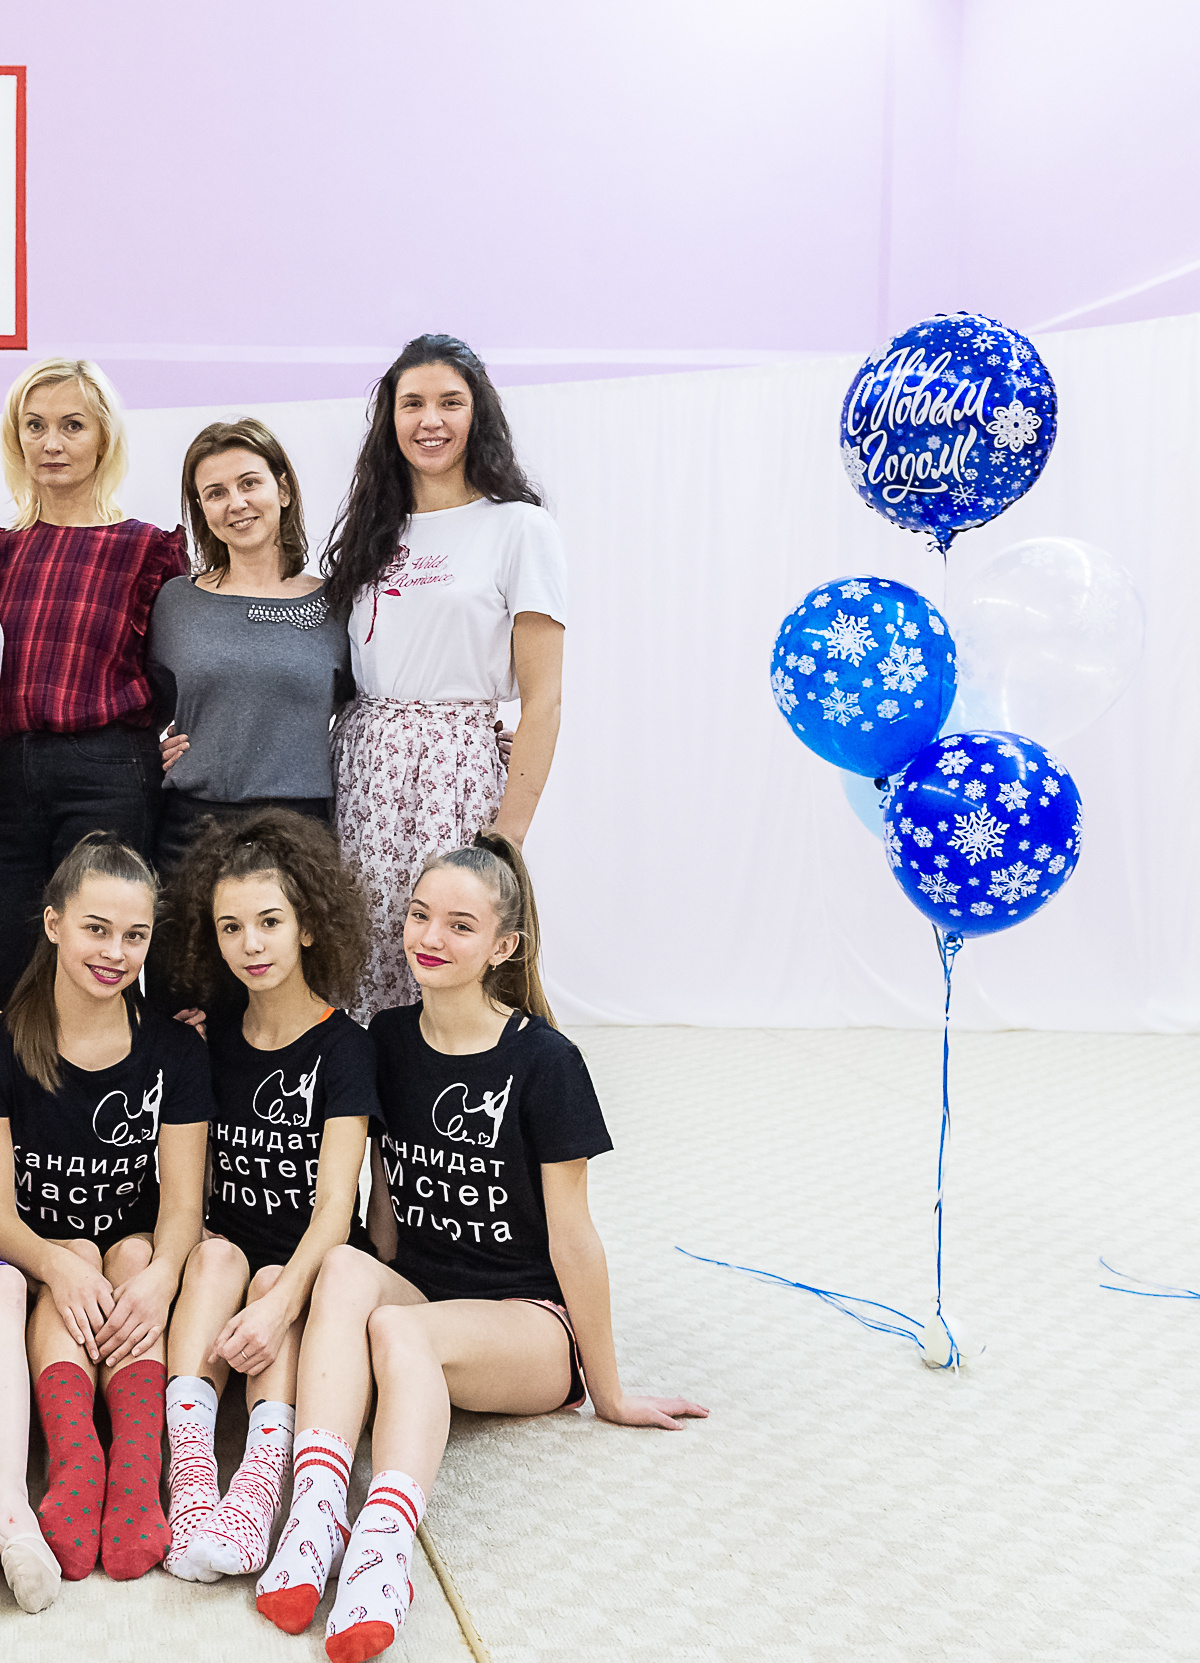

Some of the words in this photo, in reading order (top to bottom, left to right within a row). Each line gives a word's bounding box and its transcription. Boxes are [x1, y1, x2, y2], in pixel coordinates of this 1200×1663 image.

[847, 372, 875, 436] С
[870, 347, 992, 431] Новым
[862, 425, 978, 504] Годом!
[388, 572, 454, 588] Romance
[411, 555, 449, 570] Wild
[207, 1120, 320, 1153] андидат
[13, 1145, 148, 1177] андида
[218, 1151, 319, 1186] астер
[381, 1132, 505, 1178] Кндидат
[14, 1170, 146, 1202] Масте
[213, 1180, 317, 1215] порта
[383, 1157, 508, 1213] Мстер
